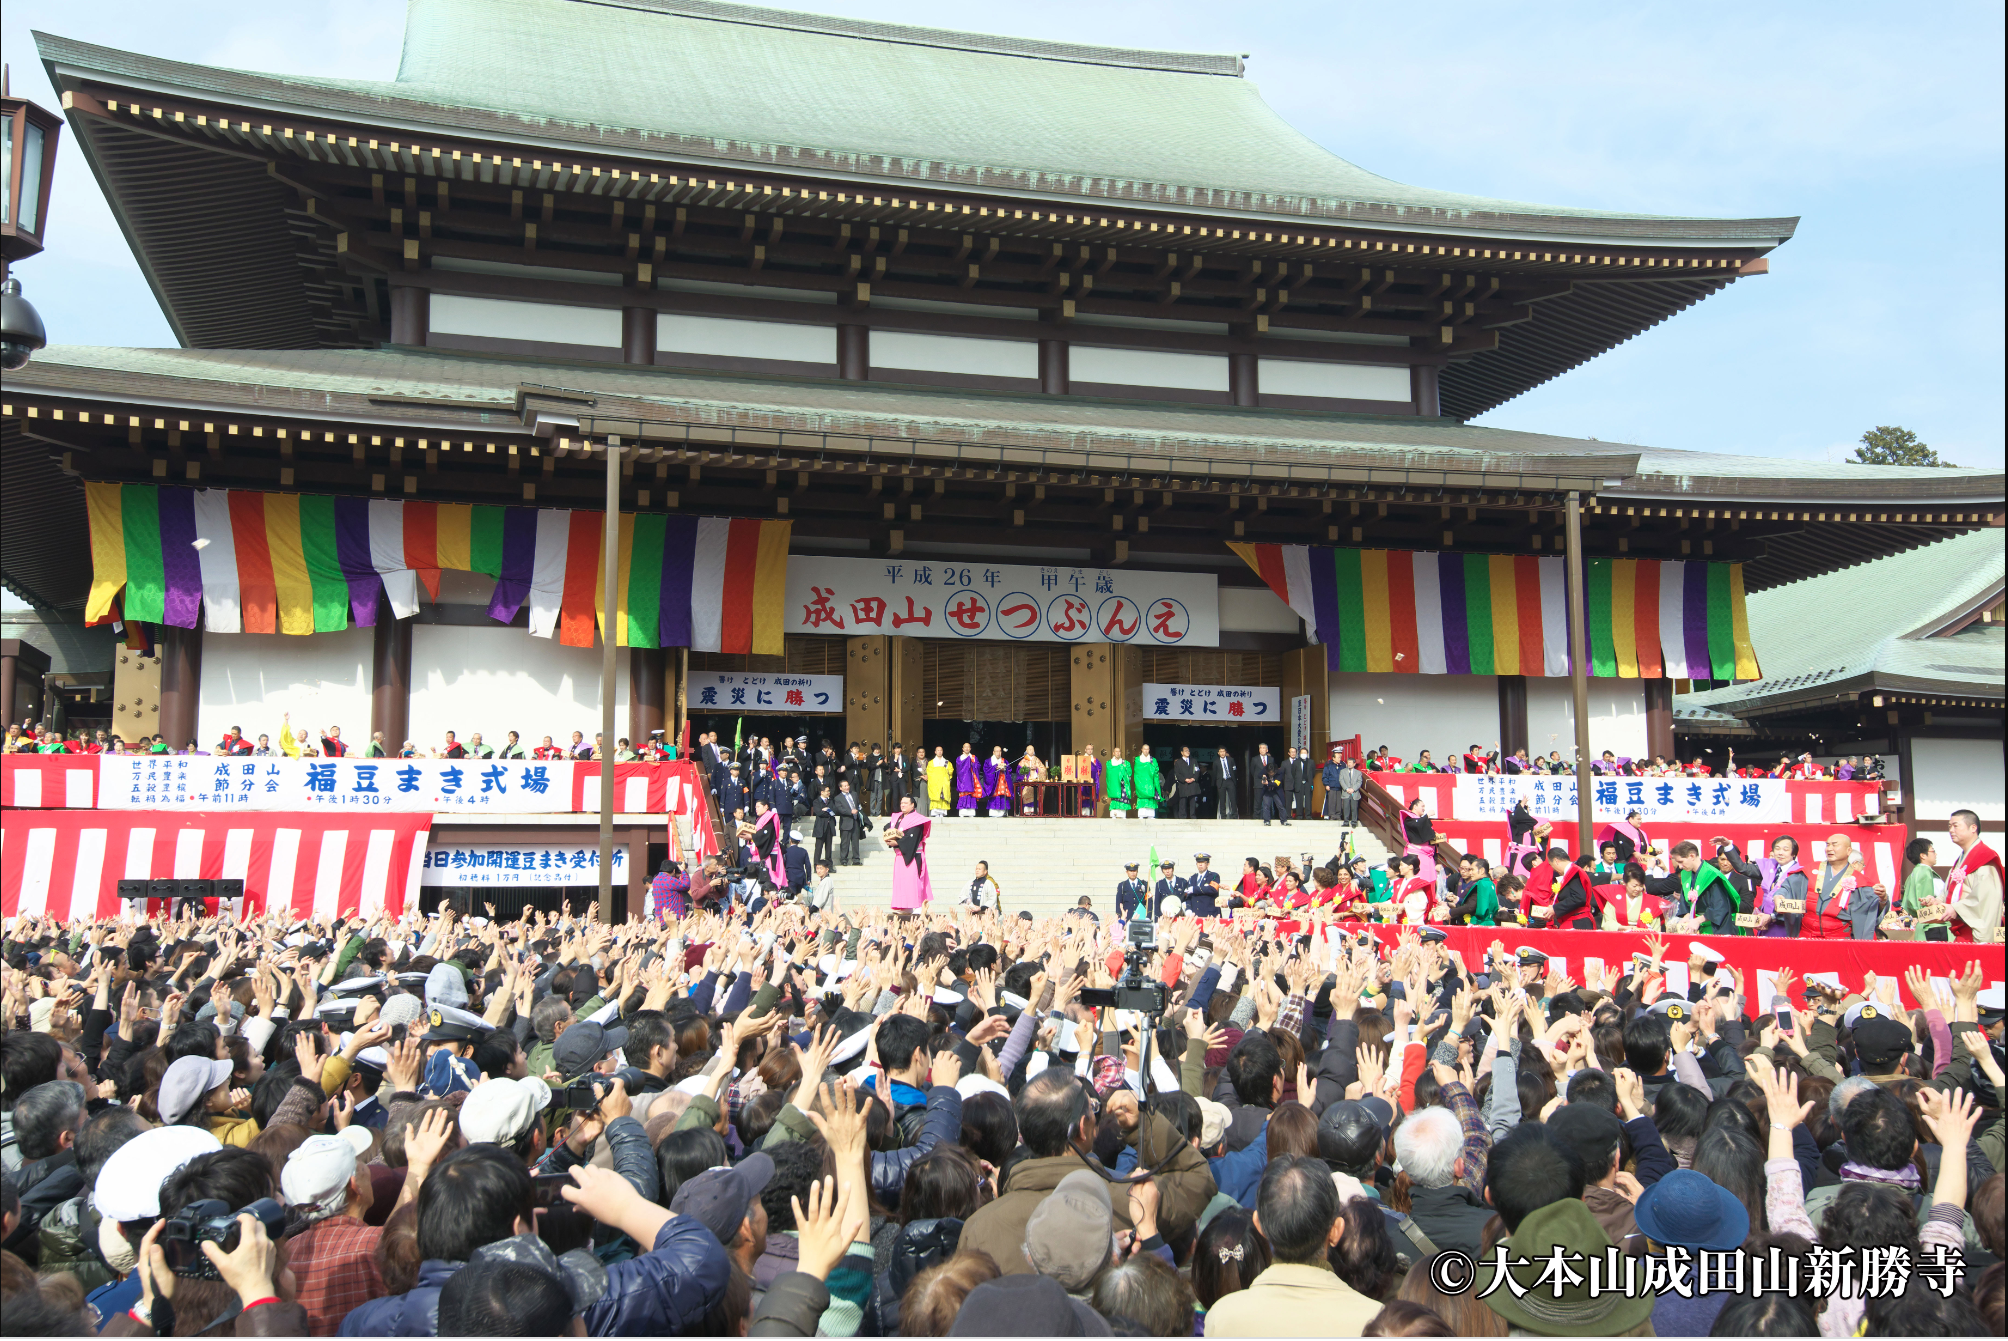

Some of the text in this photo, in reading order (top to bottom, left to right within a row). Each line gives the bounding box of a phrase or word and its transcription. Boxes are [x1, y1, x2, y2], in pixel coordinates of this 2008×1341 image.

[884, 565, 1113, 594] 平成26年 甲午歳
[718, 676, 812, 687] 響け とどけ 成田の祈り
[700, 686, 830, 707] 震災に勝つ
[1170, 688, 1253, 698] 響け とどけ 成田の祈り
[1154, 698, 1268, 717] 震災に勝つ
[131, 759, 189, 770] 世界平和
[214, 762, 281, 777] 成田山
[303, 762, 551, 795] 福豆まき式場
[214, 778, 280, 793] 節分会
[198, 793, 249, 804] 午前11時
[315, 794, 393, 805] 午後1時30分
[1595, 780, 1762, 808] 福豆まき式場
[442, 795, 490, 806] 午後4時
[1528, 807, 1560, 815] 前11時
[1692, 808, 1726, 816] 午後4時
[458, 873, 490, 882] 初穂料
[496, 873, 519, 882] 1万円
[1779, 899, 1800, 911] 成田山
